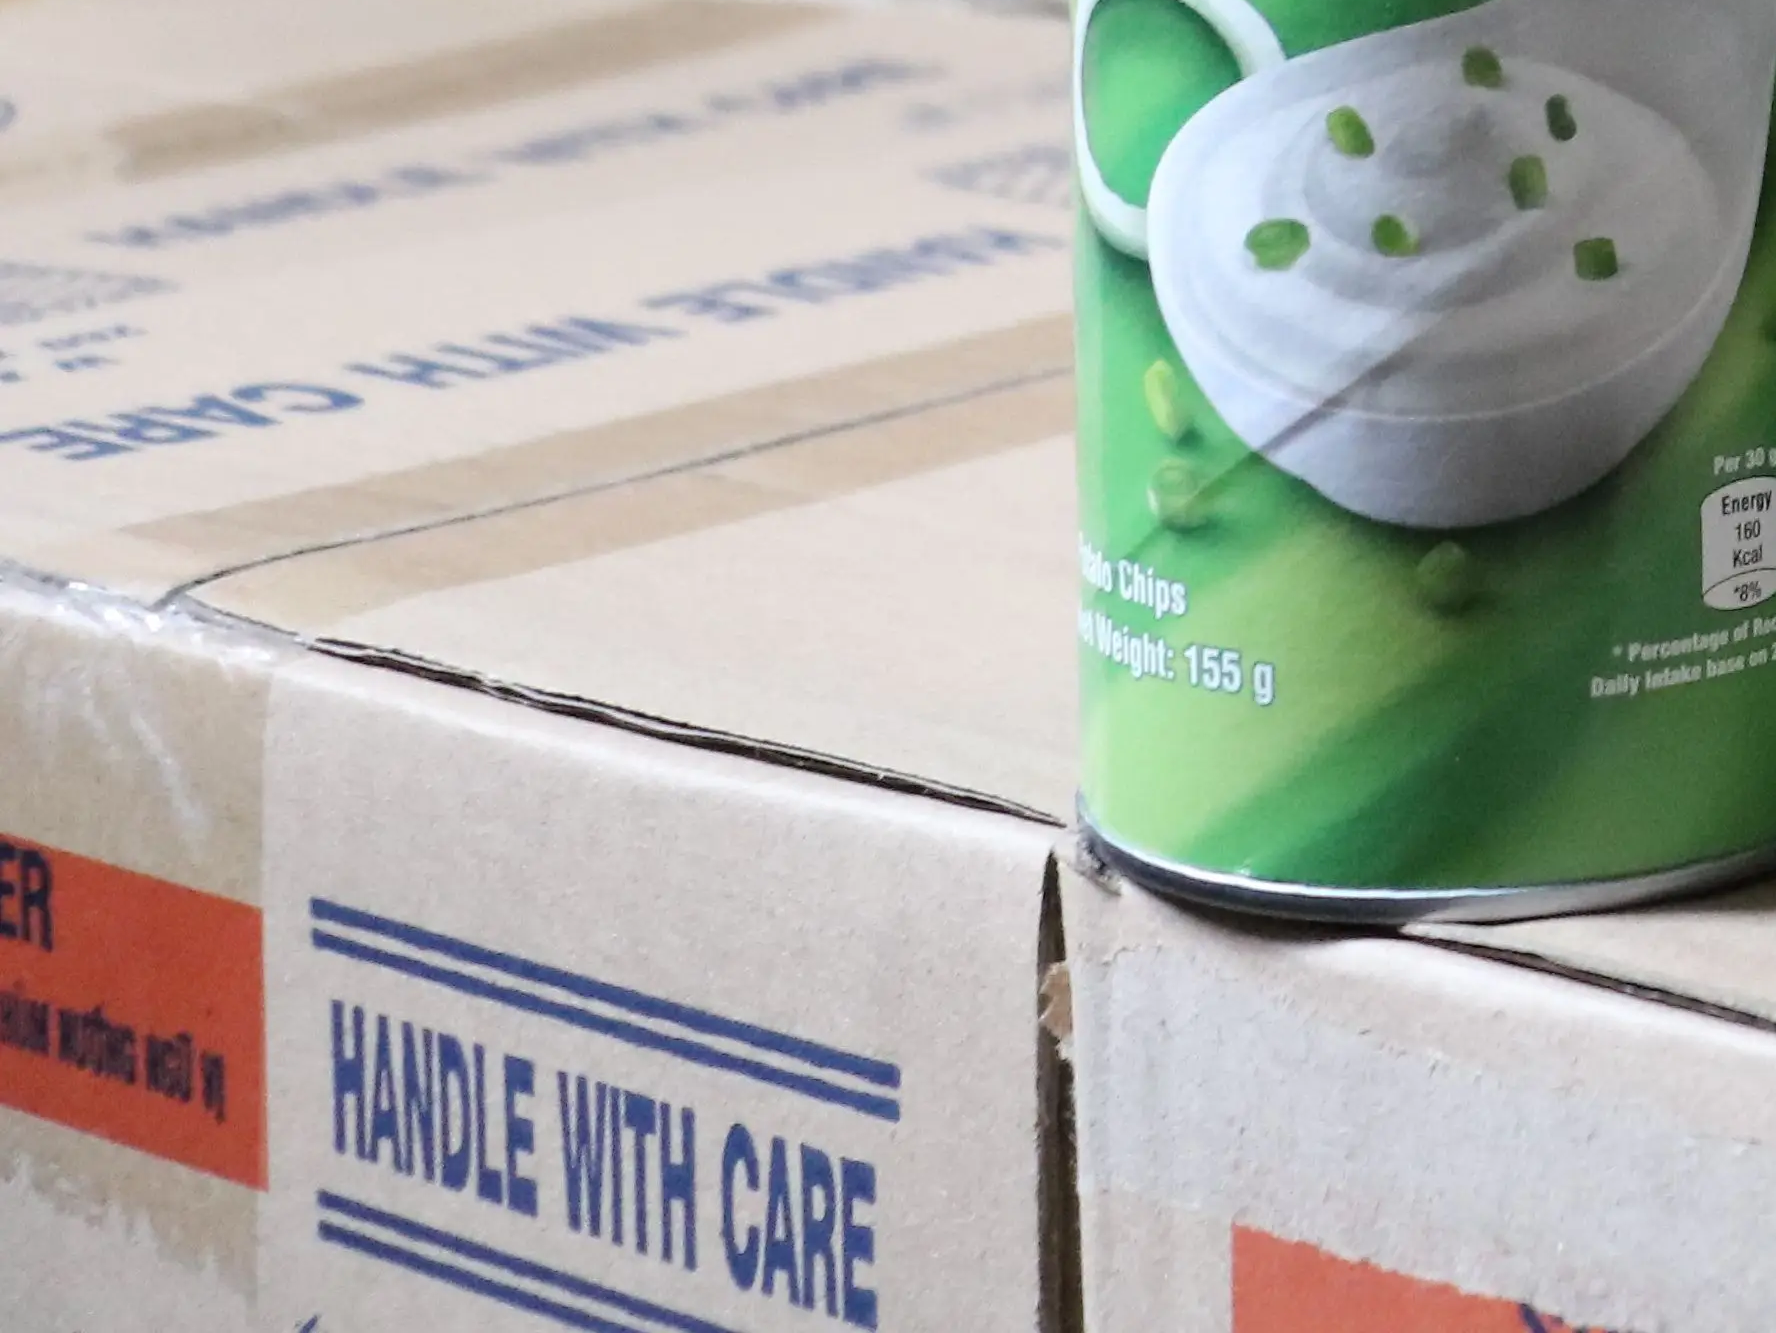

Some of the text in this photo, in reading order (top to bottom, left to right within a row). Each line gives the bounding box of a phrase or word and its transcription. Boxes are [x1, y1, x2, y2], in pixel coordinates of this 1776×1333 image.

[343, 316, 690, 390] WITH
[0, 381, 366, 462] CARE
[1713, 455, 1740, 476] Per
[1721, 489, 1773, 517] Energy
[1734, 519, 1761, 542] 160
[1732, 544, 1763, 569] Kcal
[1117, 558, 1188, 621] Chips
[1095, 610, 1175, 680] Weight:
[1183, 644, 1242, 694] 155
[1253, 662, 1275, 706] g
[1627, 628, 1729, 663] Percentage
[330, 998, 882, 1332] HANDLE WITH CARE
